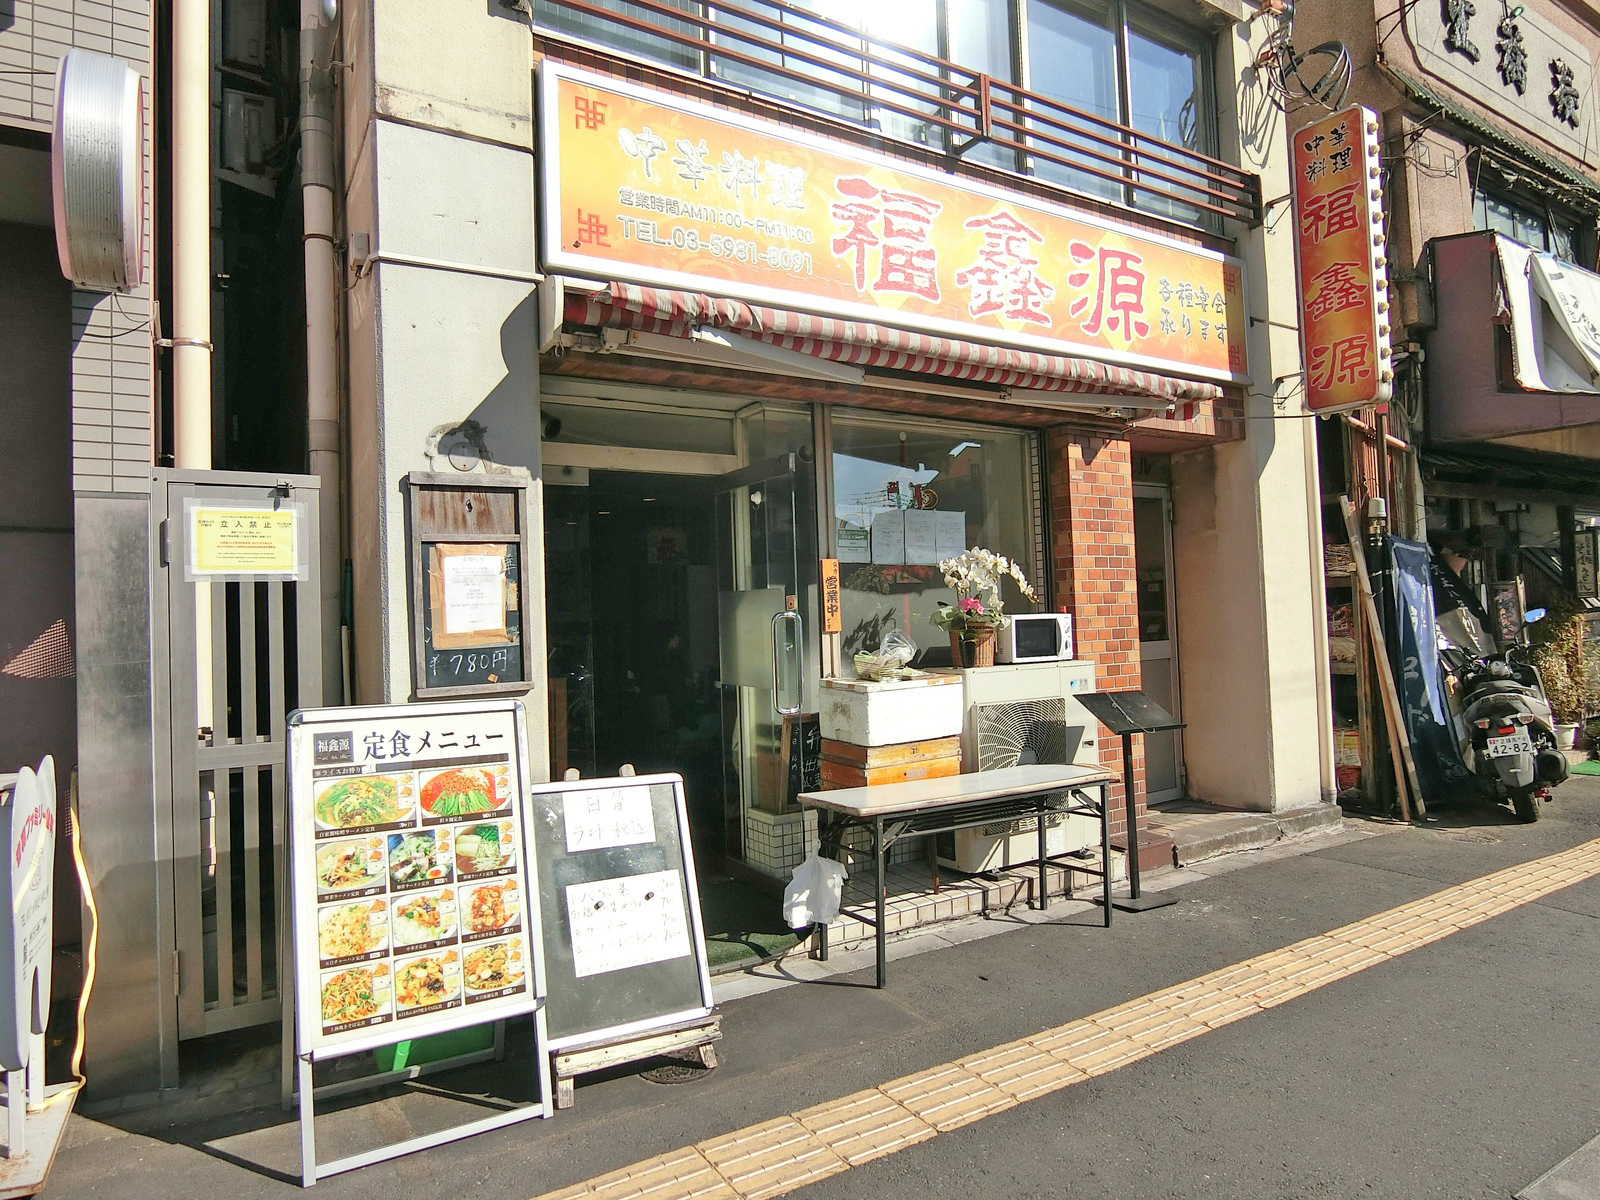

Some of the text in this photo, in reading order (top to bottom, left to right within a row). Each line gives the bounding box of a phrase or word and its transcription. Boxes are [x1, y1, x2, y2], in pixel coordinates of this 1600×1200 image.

[1304, 121, 1349, 156] 中華
[618, 125, 808, 210] 中華料理
[1304, 147, 1352, 182] 料理
[830, 176, 1152, 342] 福鑫源
[1158, 277, 1227, 315] 各種宴会
[1302, 182, 1370, 390] 福鑫源
[1160, 308, 1227, 344] 承ります
[220, 520, 272, 529] 立入禁止
[825, 575, 839, 618] 営業中
[317, 738, 351, 753] 福鑫源
[363, 729, 504, 761] 定食メニュー
[1492, 742, 1529, 755] 42-82
